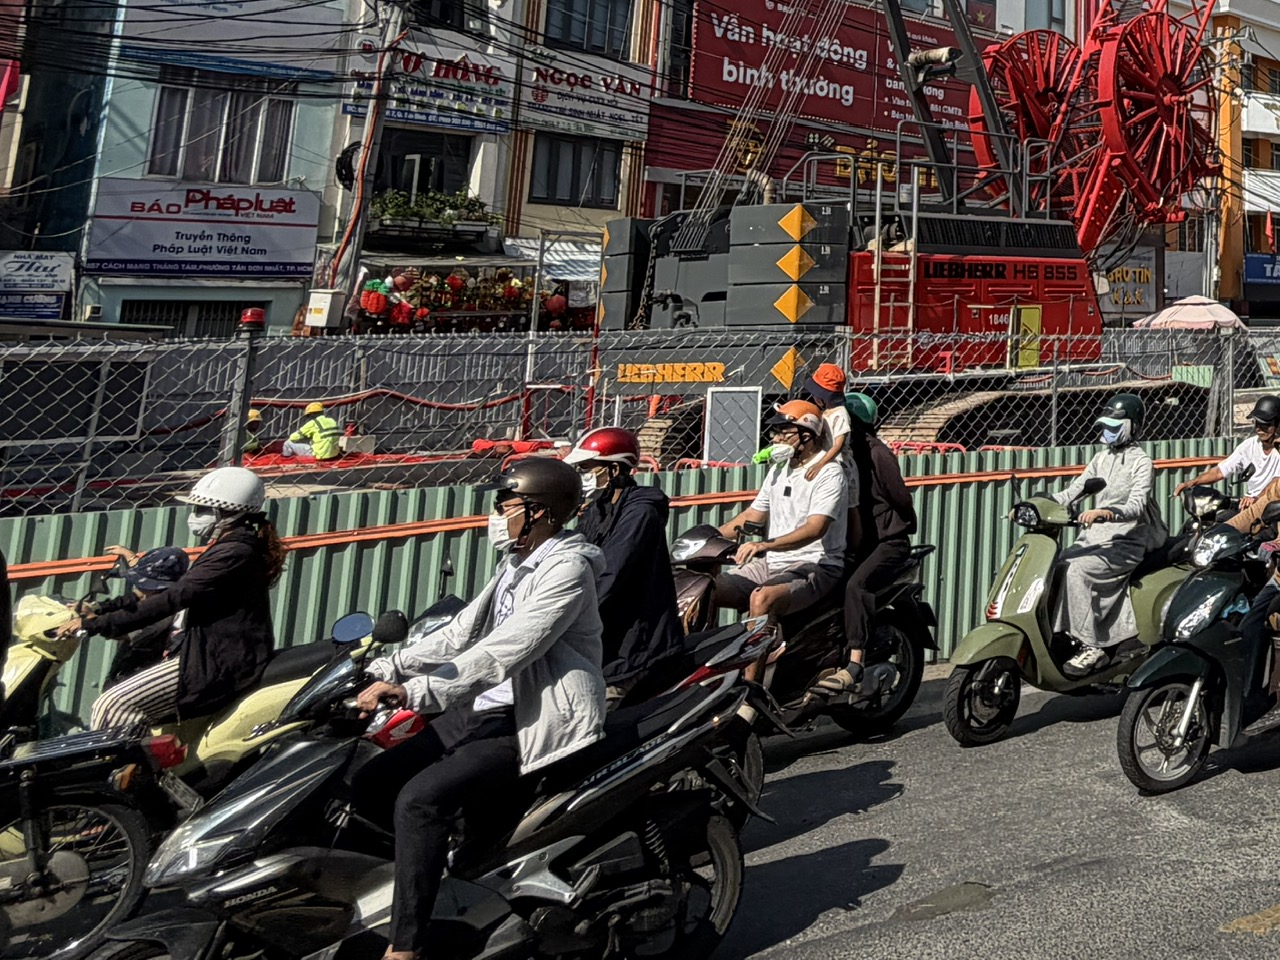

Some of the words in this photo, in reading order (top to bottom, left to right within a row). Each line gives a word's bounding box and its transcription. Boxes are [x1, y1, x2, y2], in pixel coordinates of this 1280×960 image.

[130, 198, 182, 214] BÁO
[175, 229, 213, 242] Truyền
[217, 231, 251, 244] Thông
[152, 243, 184, 255] Pháp
[188, 244, 213, 257] Luật
[217, 245, 237, 257] Việt
[240, 246, 267, 255] Nam
[924, 261, 1007, 280] LIEBHERR
[1013, 264, 1039, 280] HS
[1044, 265, 1078, 281] 855
[617, 362, 725, 383] LIEBHERR
[224, 886, 278, 908] HONDA
